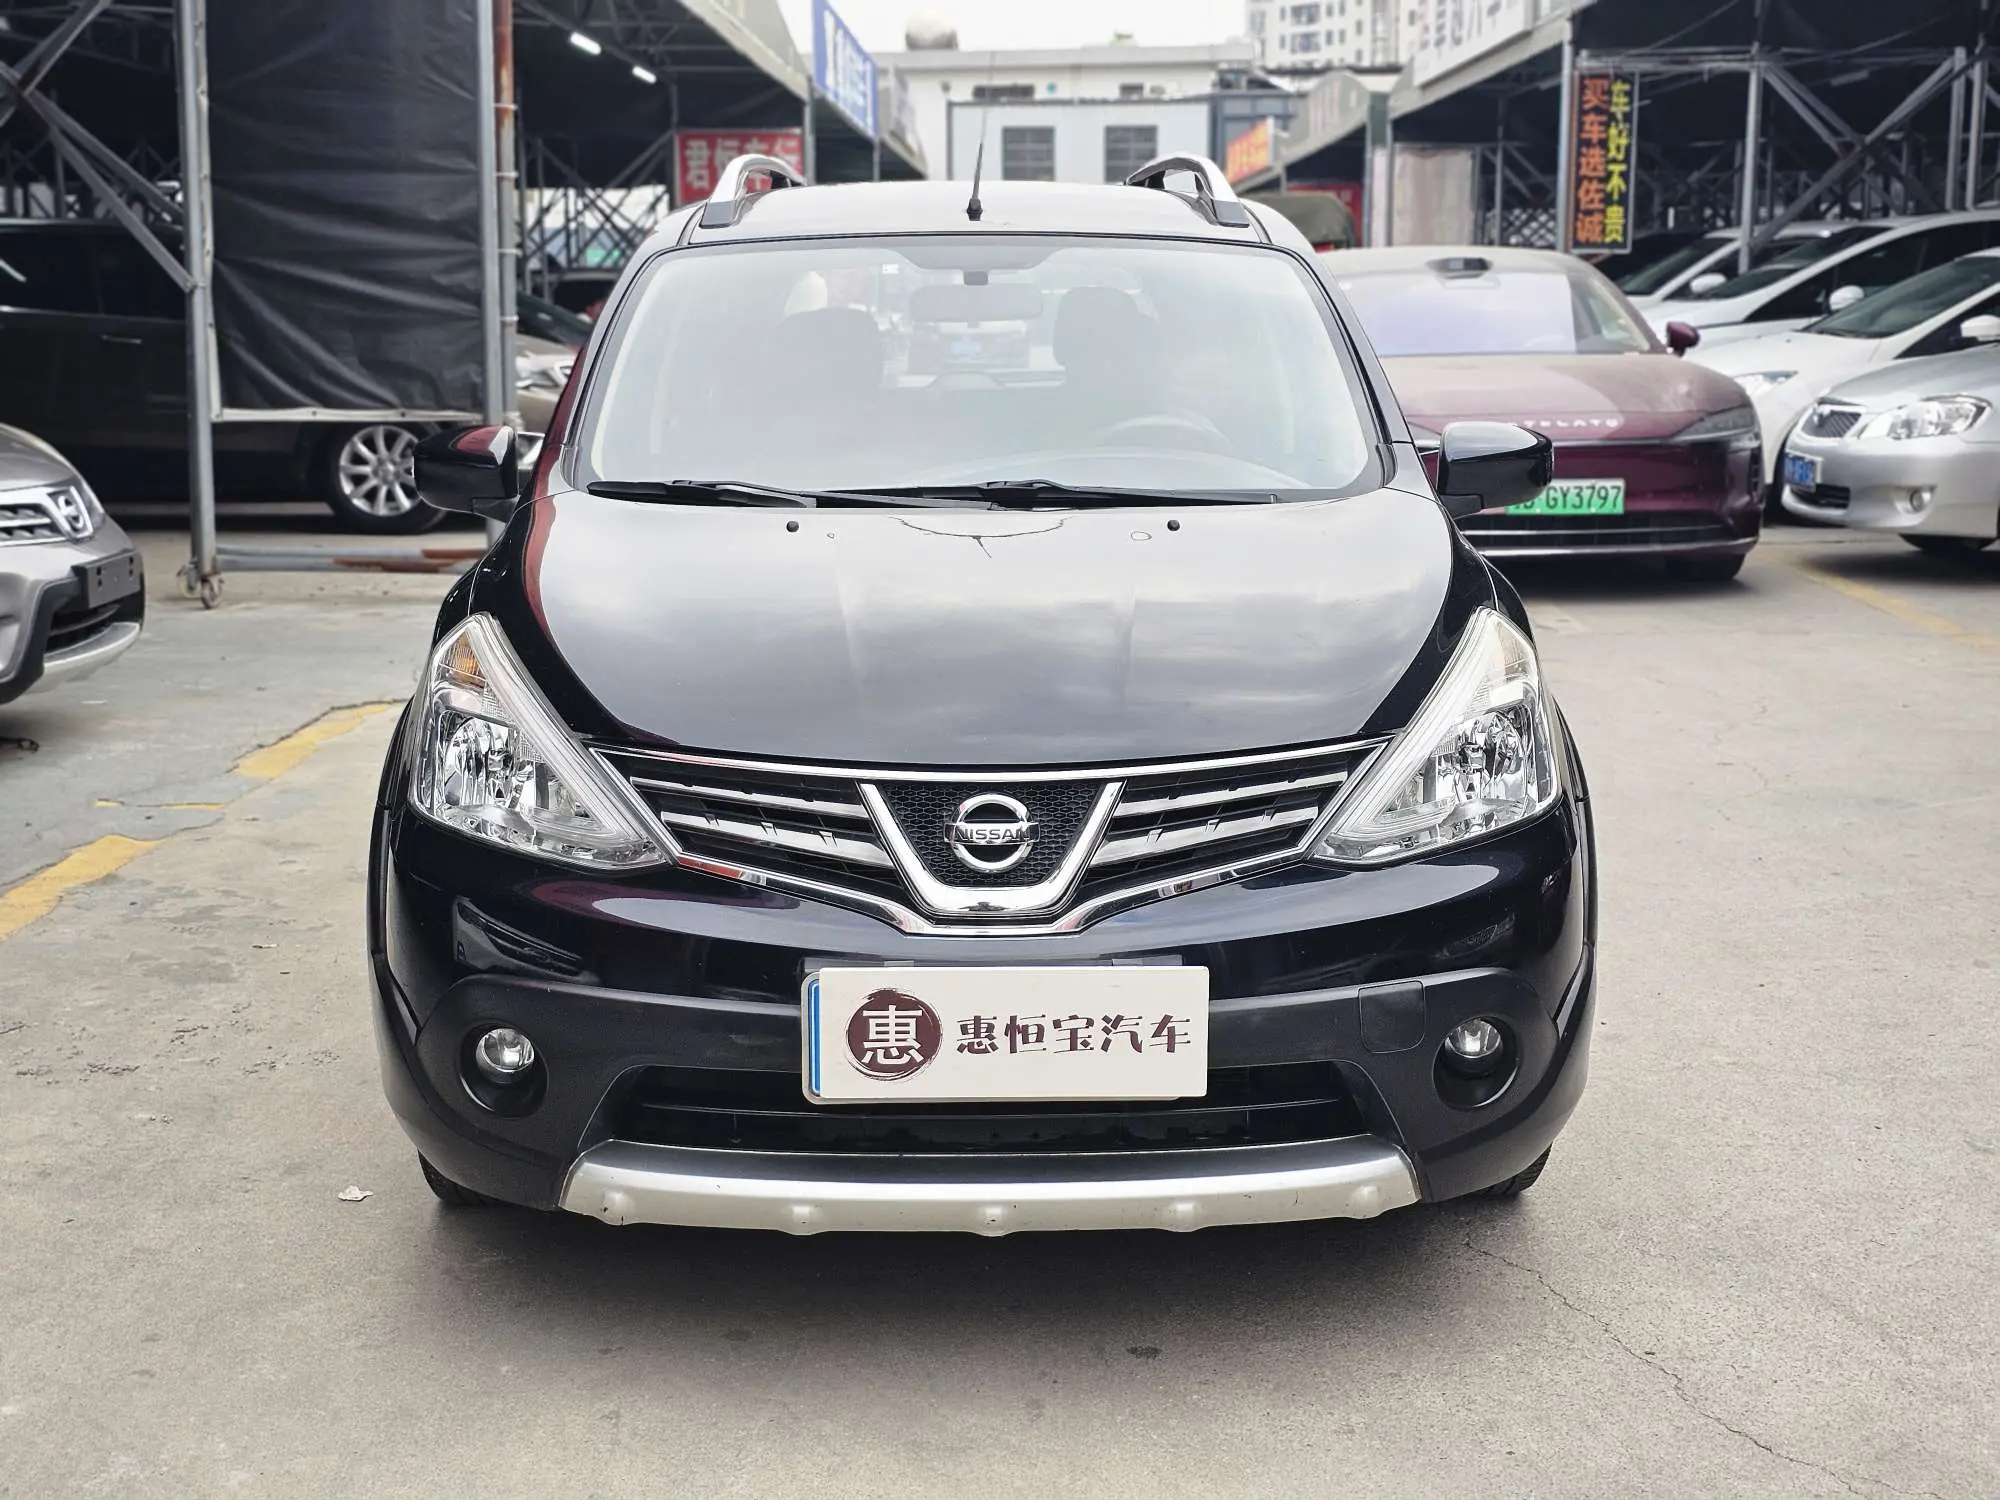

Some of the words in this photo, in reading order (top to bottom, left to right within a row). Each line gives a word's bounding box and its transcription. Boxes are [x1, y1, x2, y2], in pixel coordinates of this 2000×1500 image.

[1604, 78, 1630, 244] 车好不贵
[1512, 418, 1619, 428] TELATO
[955, 828, 1031, 842] NISSAN
[861, 1003, 924, 1066] 惠
[956, 1013, 1192, 1055] 惠恒宝汽车
